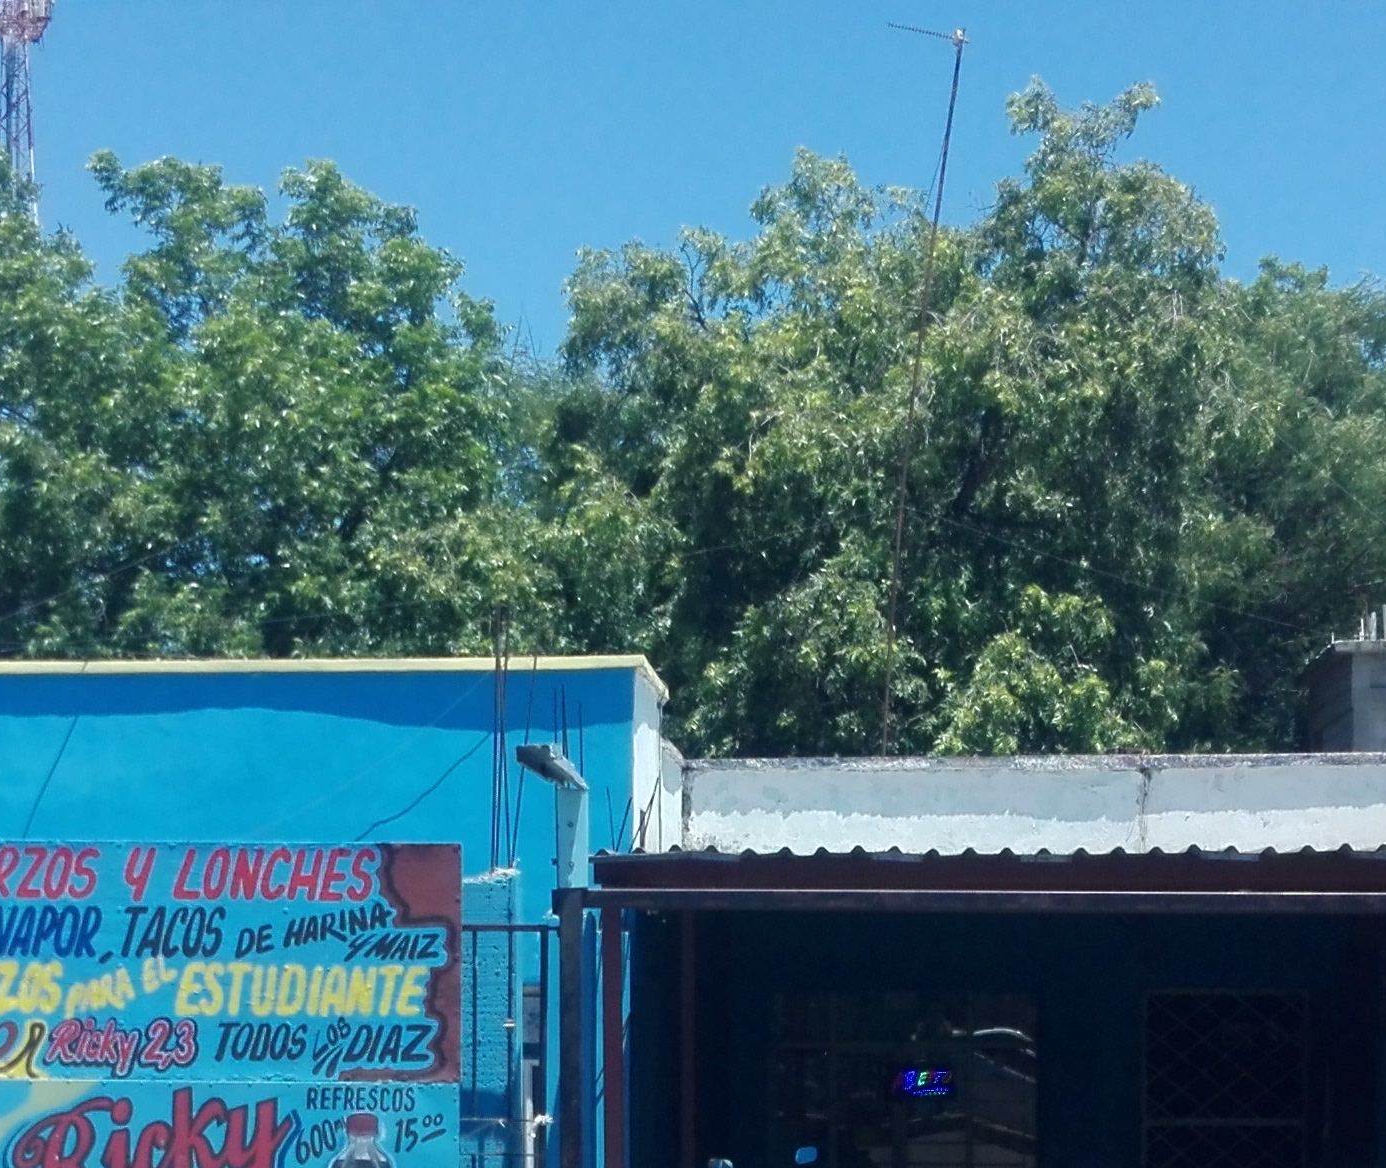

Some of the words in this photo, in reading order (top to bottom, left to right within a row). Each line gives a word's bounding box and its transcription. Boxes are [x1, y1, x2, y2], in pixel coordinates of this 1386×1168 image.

[125, 846, 156, 900] Y
[173, 847, 377, 900] LONCHES
[121, 905, 226, 959] TACOS
[235, 924, 275, 959] DE
[283, 903, 392, 948] HARINA
[364, 933, 439, 960] MAIZ
[143, 956, 177, 992] EL
[176, 963, 429, 1017] ESTUDIANTE
[47, 1017, 138, 1076] Ricky
[215, 1021, 308, 1062] TODOS
[342, 1024, 432, 1063] DIAZ
[306, 1087, 416, 1112] REFRESCOS
